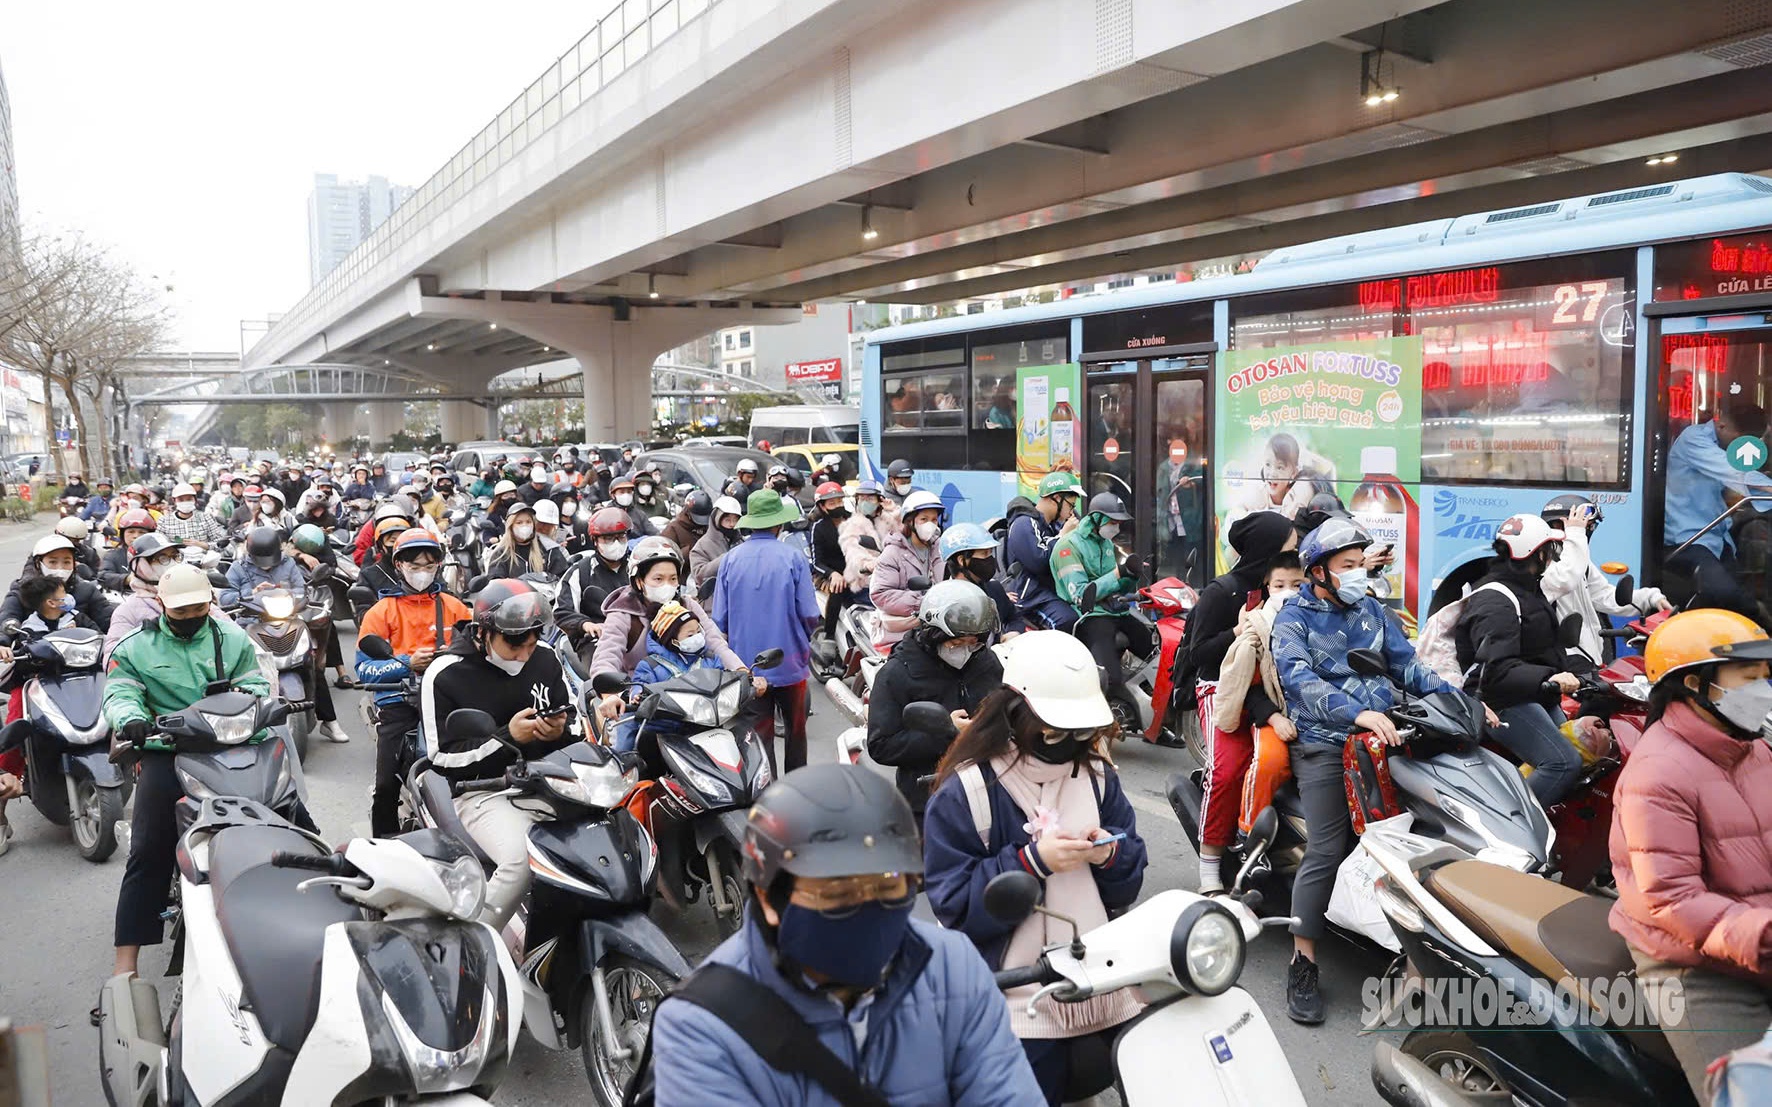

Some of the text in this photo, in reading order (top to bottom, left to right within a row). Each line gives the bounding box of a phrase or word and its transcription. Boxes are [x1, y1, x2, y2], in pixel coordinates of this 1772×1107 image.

[1717, 276, 1750, 294] CỬA
[1552, 281, 1608, 324] 27
[1227, 354, 1308, 393] OTOSAN
[1313, 351, 1401, 386] FORTUSS
[1258, 380, 1365, 406] Bảo vệ họng
[1272, 407, 1300, 427] yêu
[1302, 402, 1338, 424] hiệu
[1339, 408, 1374, 429] quả
[1046, 478, 1065, 488] Grab
[530, 682, 551, 711] NY
